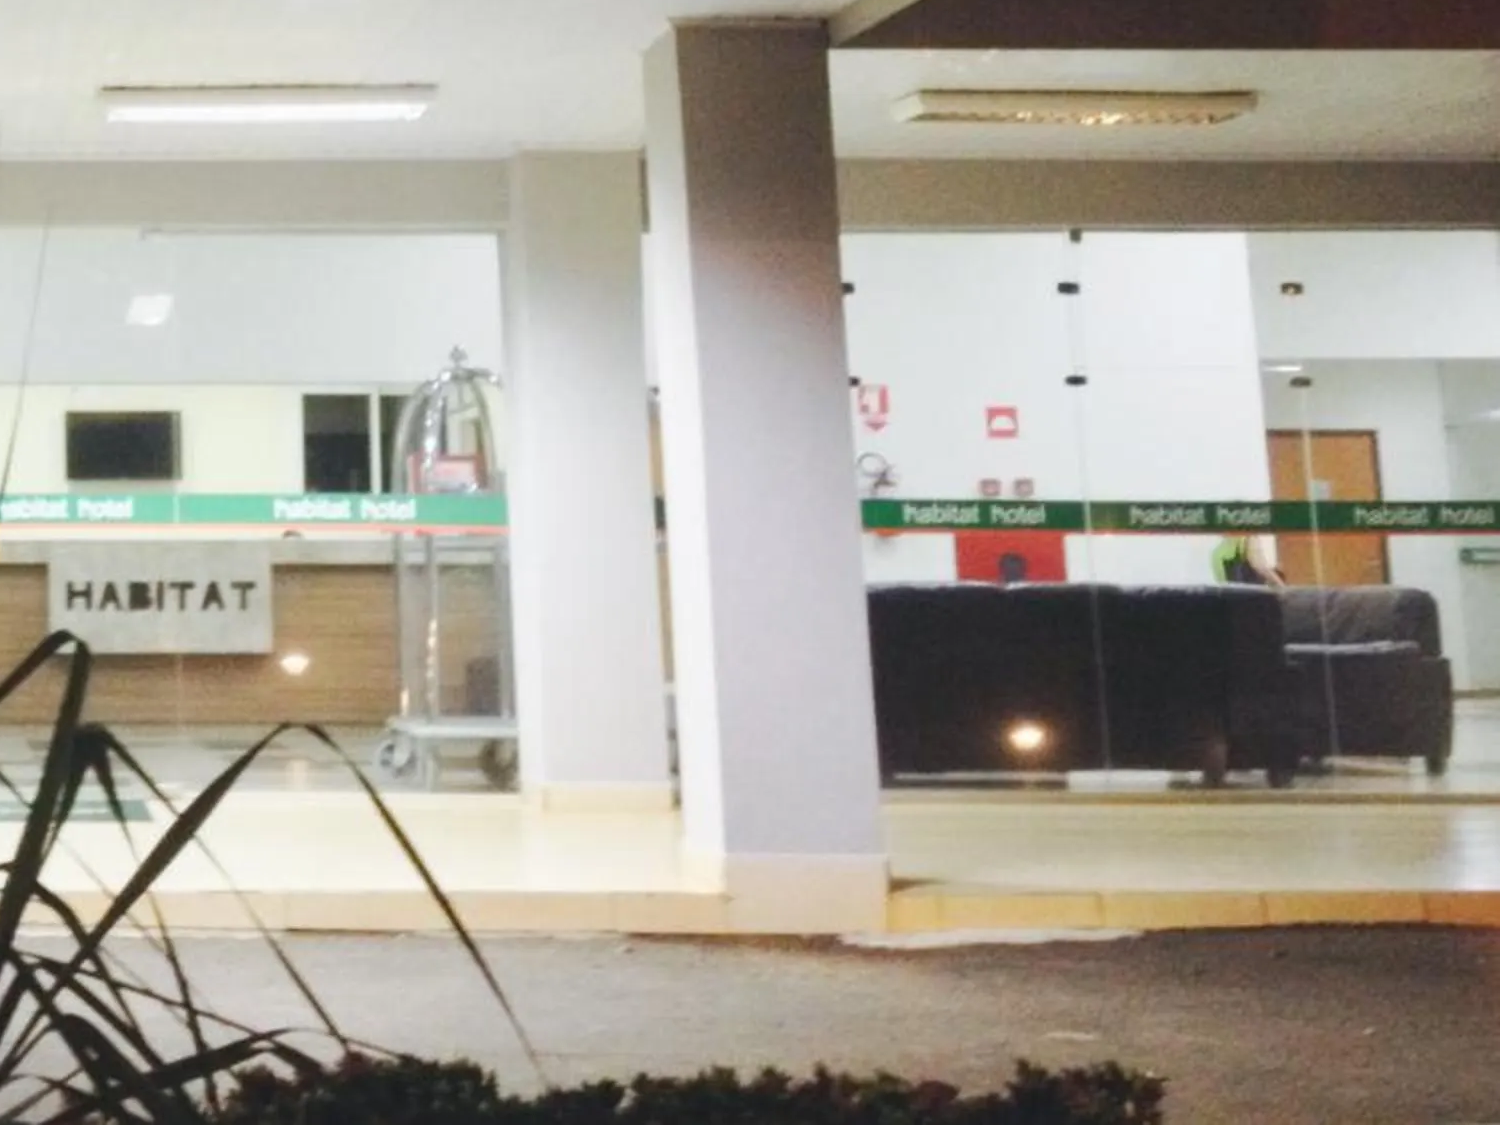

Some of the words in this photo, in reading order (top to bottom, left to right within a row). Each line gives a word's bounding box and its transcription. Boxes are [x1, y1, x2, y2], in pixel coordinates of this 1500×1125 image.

[903, 503, 980, 525] habitat
[990, 503, 1046, 525] hotel
[1130, 504, 1207, 526] habitat
[1216, 504, 1271, 526] hotel
[1354, 504, 1429, 525] habitat
[1440, 504, 1495, 525] hotel
[66, 580, 257, 612] HABITAT
